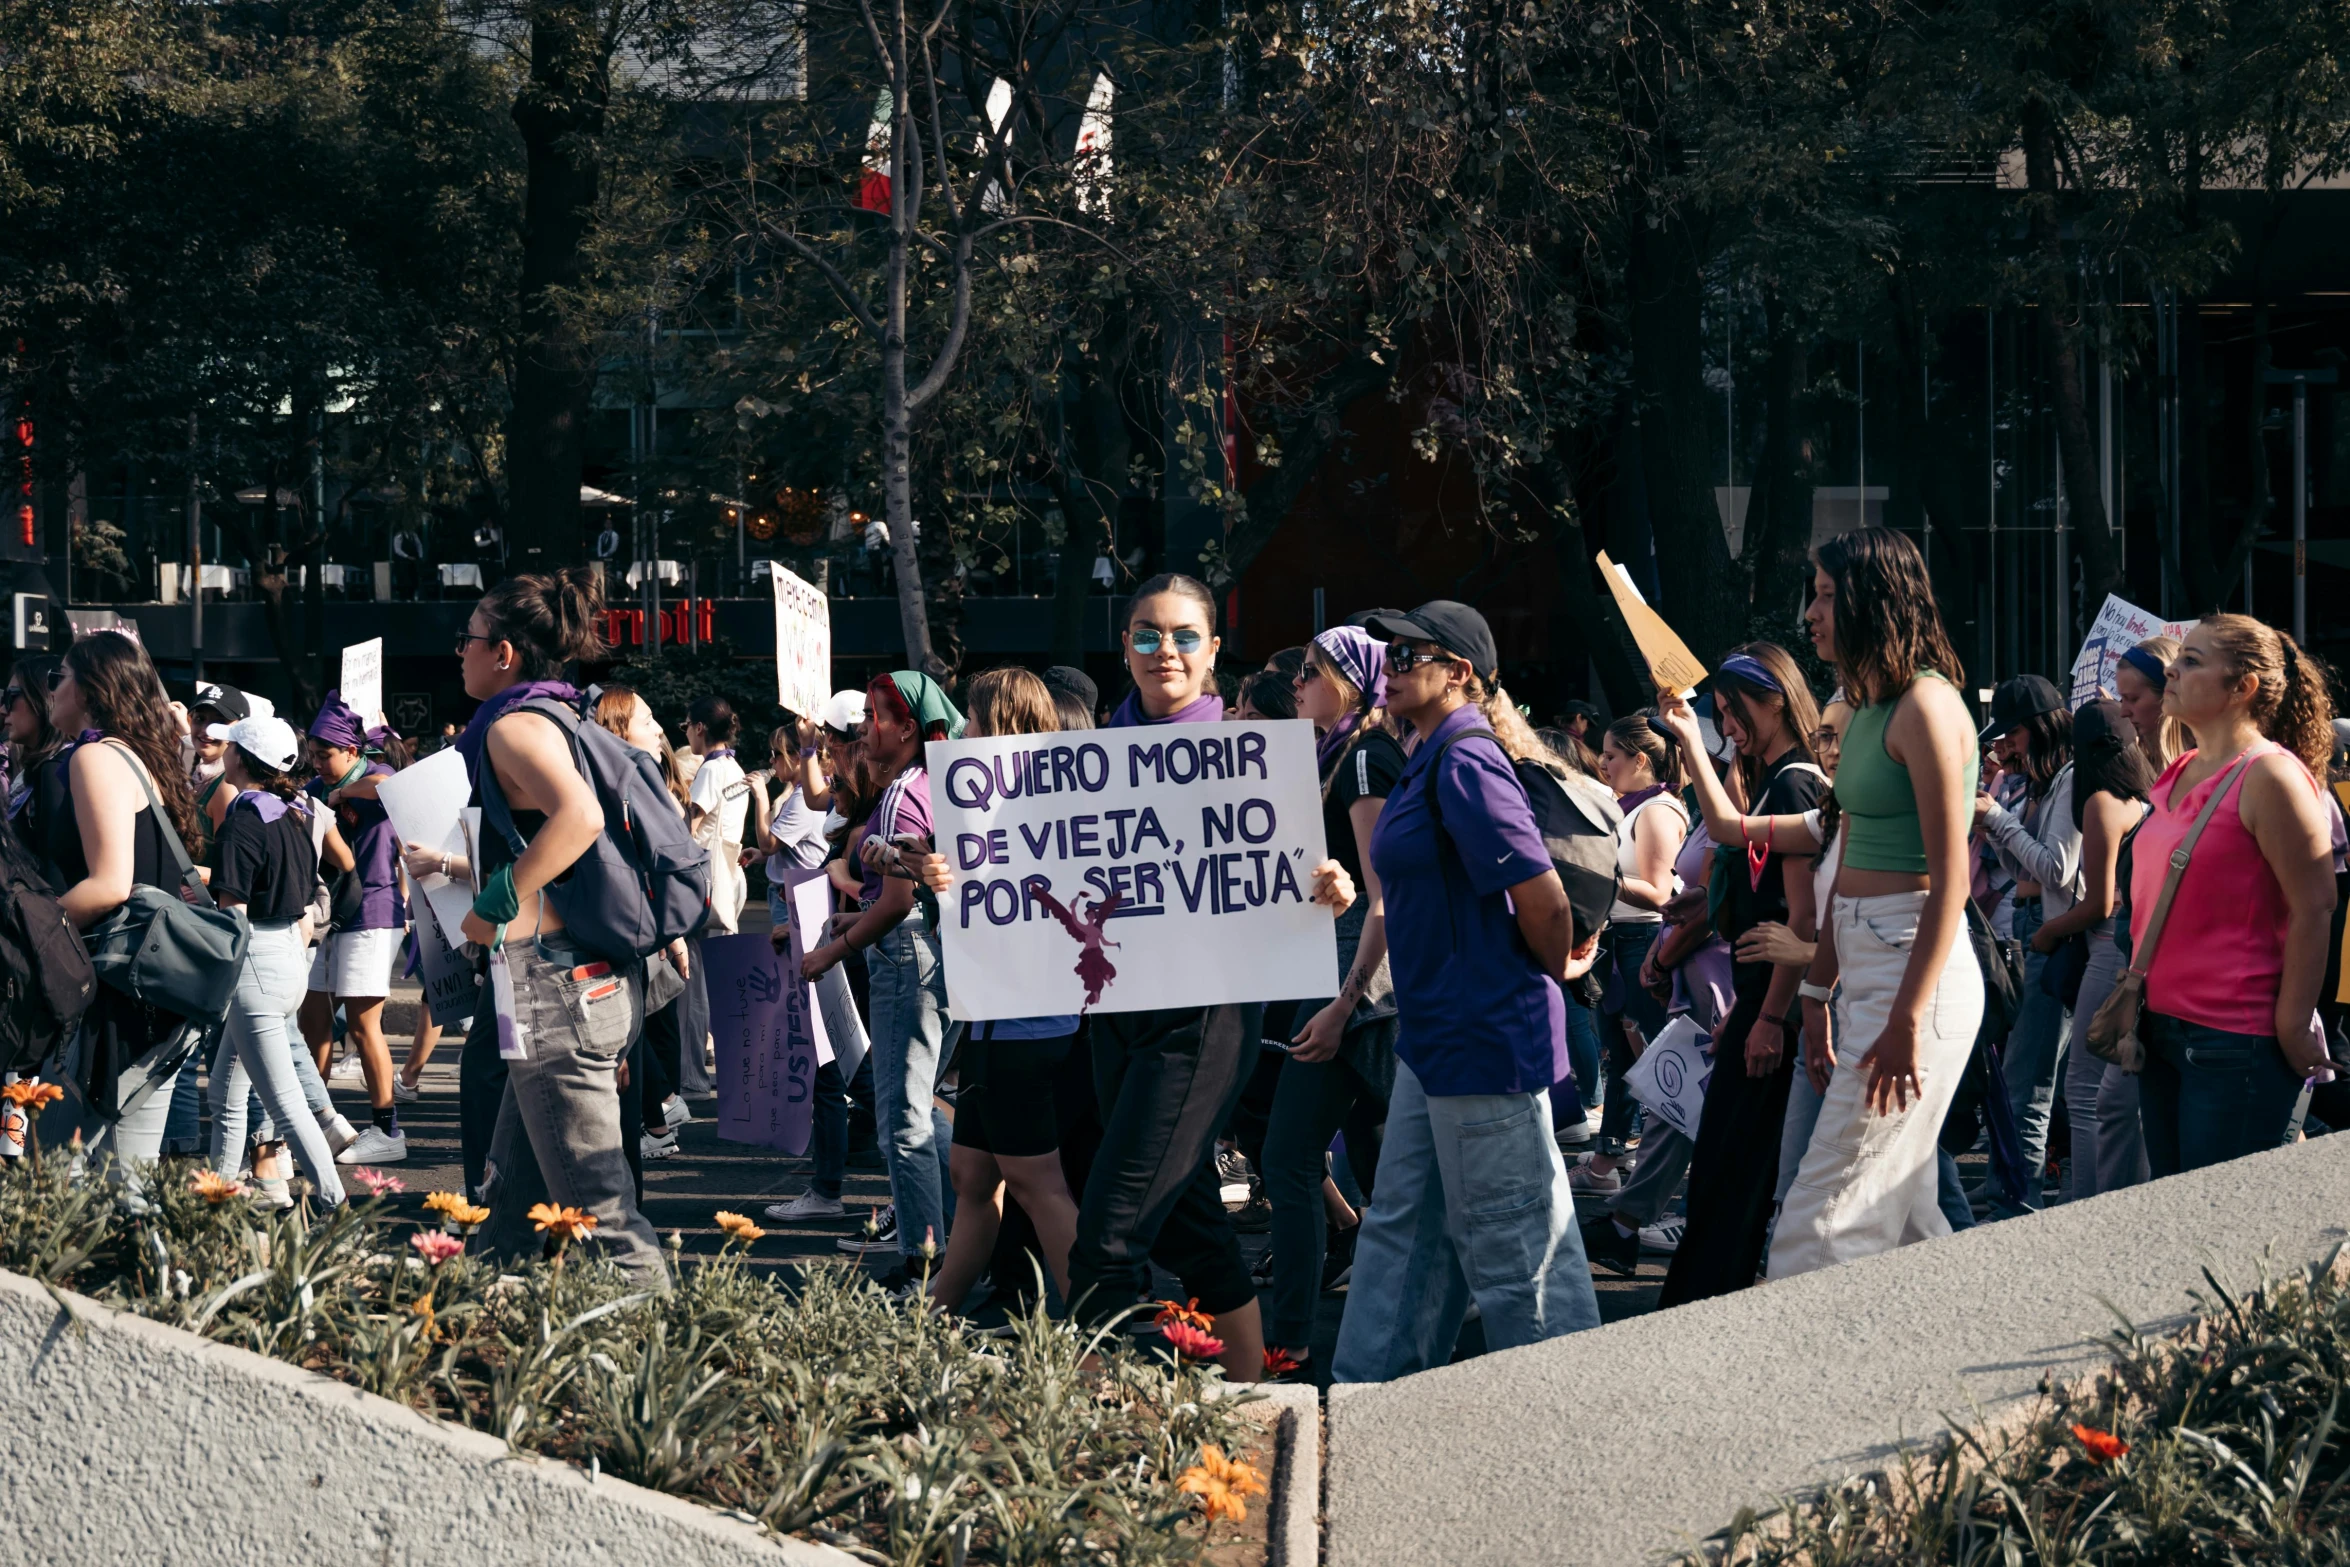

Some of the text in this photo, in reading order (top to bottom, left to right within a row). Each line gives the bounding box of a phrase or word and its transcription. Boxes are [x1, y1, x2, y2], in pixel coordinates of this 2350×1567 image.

[2100, 601, 2116, 621] No
[2112, 607, 2128, 632] hay
[946, 731, 1267, 812] QUIERO MORIR
[957, 798, 1276, 870] DE VIEJA, NO
[961, 874, 1051, 928] POR
[1083, 861, 1165, 909] SER
[432, 973, 462, 997] UNA
[728, 977, 756, 1122] Lo que no tuve
[758, 1053, 767, 1089] para
[769, 1028, 784, 1132] que sea para
